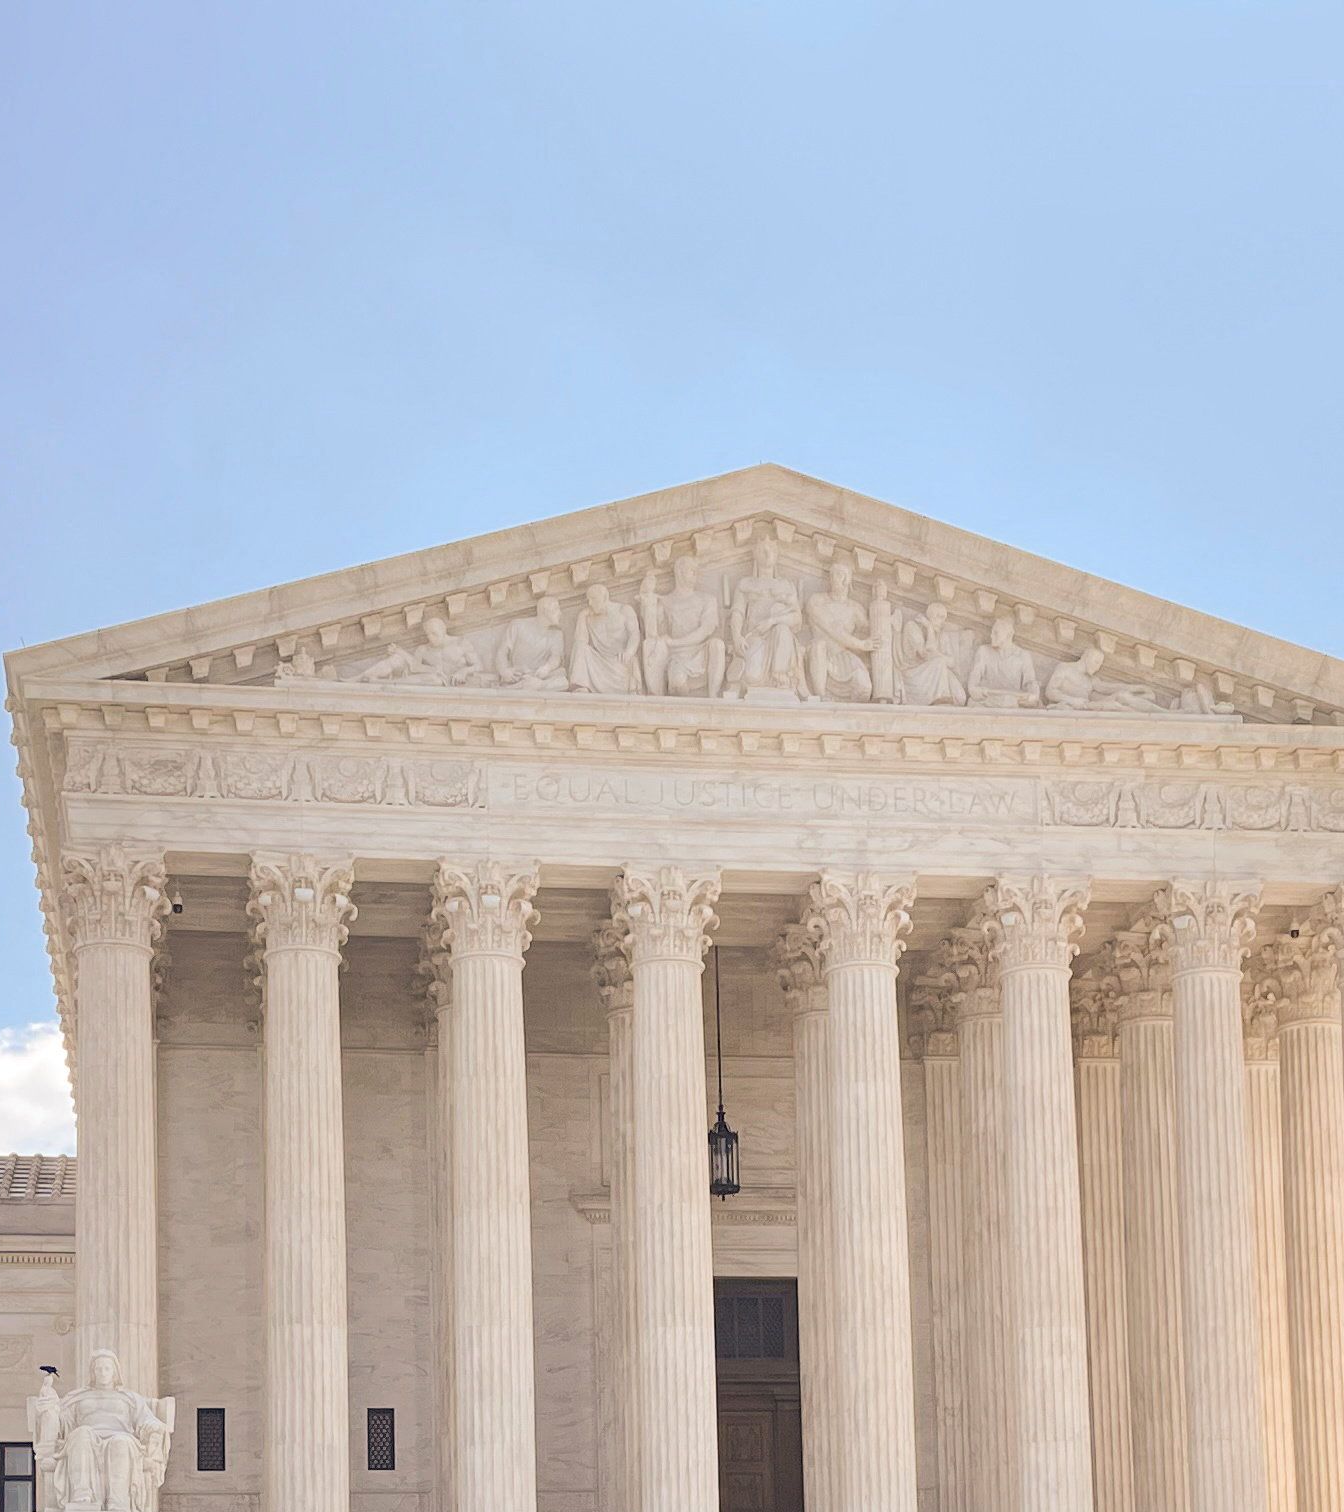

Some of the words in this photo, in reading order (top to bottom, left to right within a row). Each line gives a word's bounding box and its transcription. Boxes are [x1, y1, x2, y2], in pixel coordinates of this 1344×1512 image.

[513, 774, 640, 805] EQUAL
[656, 779, 793, 809] JUSTICE
[813, 782, 930, 813] UNDER
[948, 786, 1019, 815] LAW
